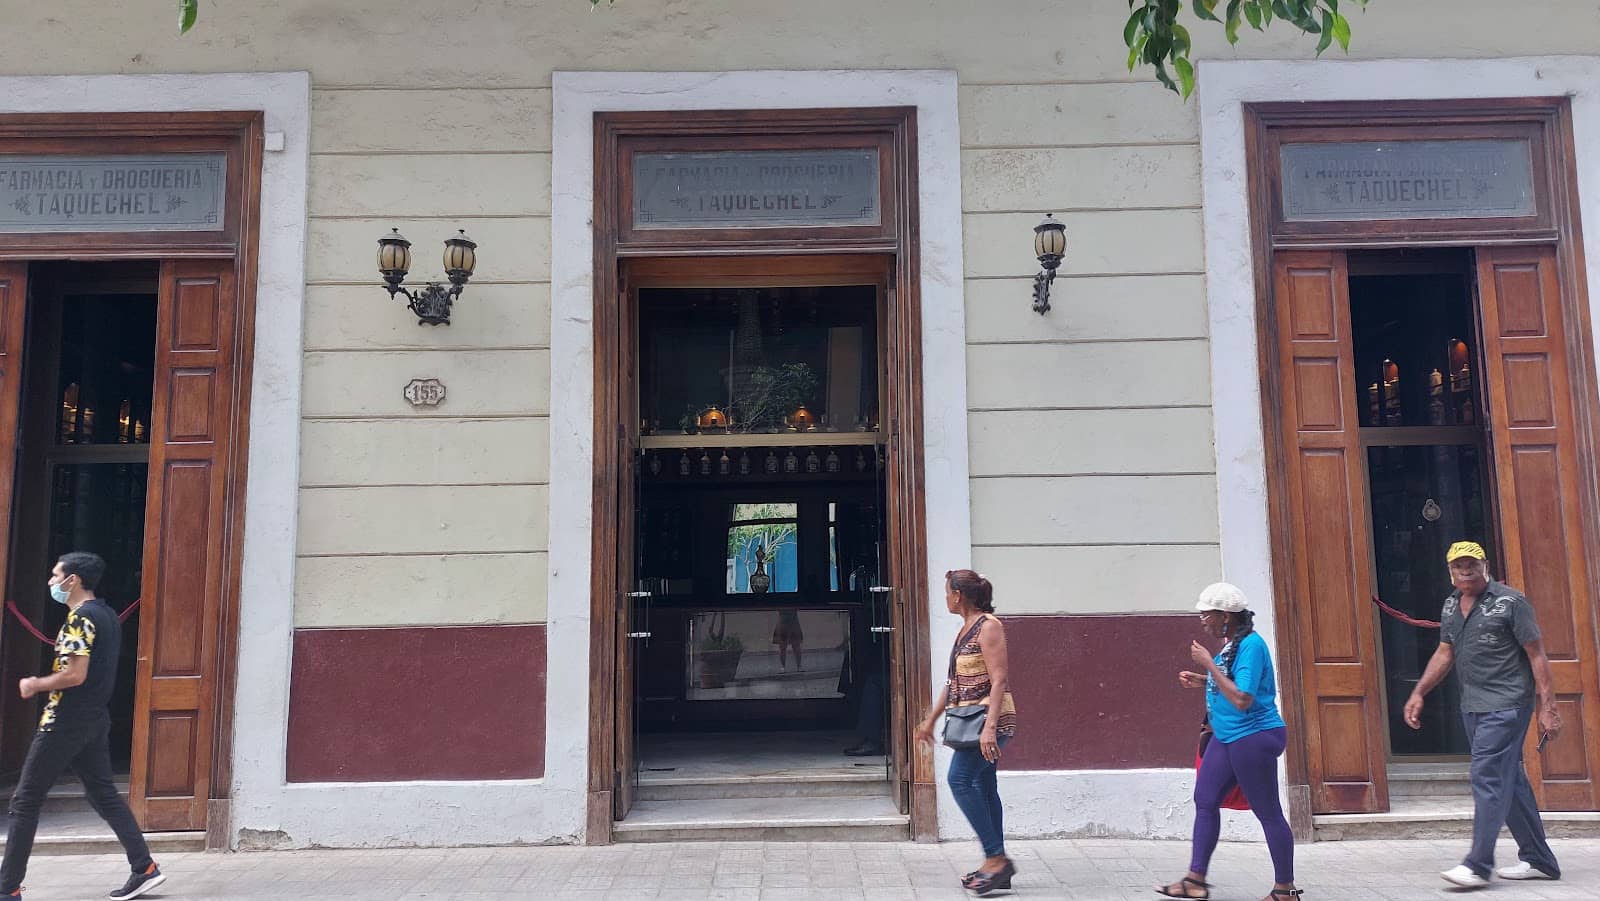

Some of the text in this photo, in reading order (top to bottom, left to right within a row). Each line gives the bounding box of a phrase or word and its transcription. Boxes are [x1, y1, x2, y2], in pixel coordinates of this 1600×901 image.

[103, 168, 202, 190] DROGUERIA
[1345, 179, 1468, 204] TAQUECHEL
[37, 192, 161, 218] TAQUECHEL
[413, 385, 438, 401] 155
